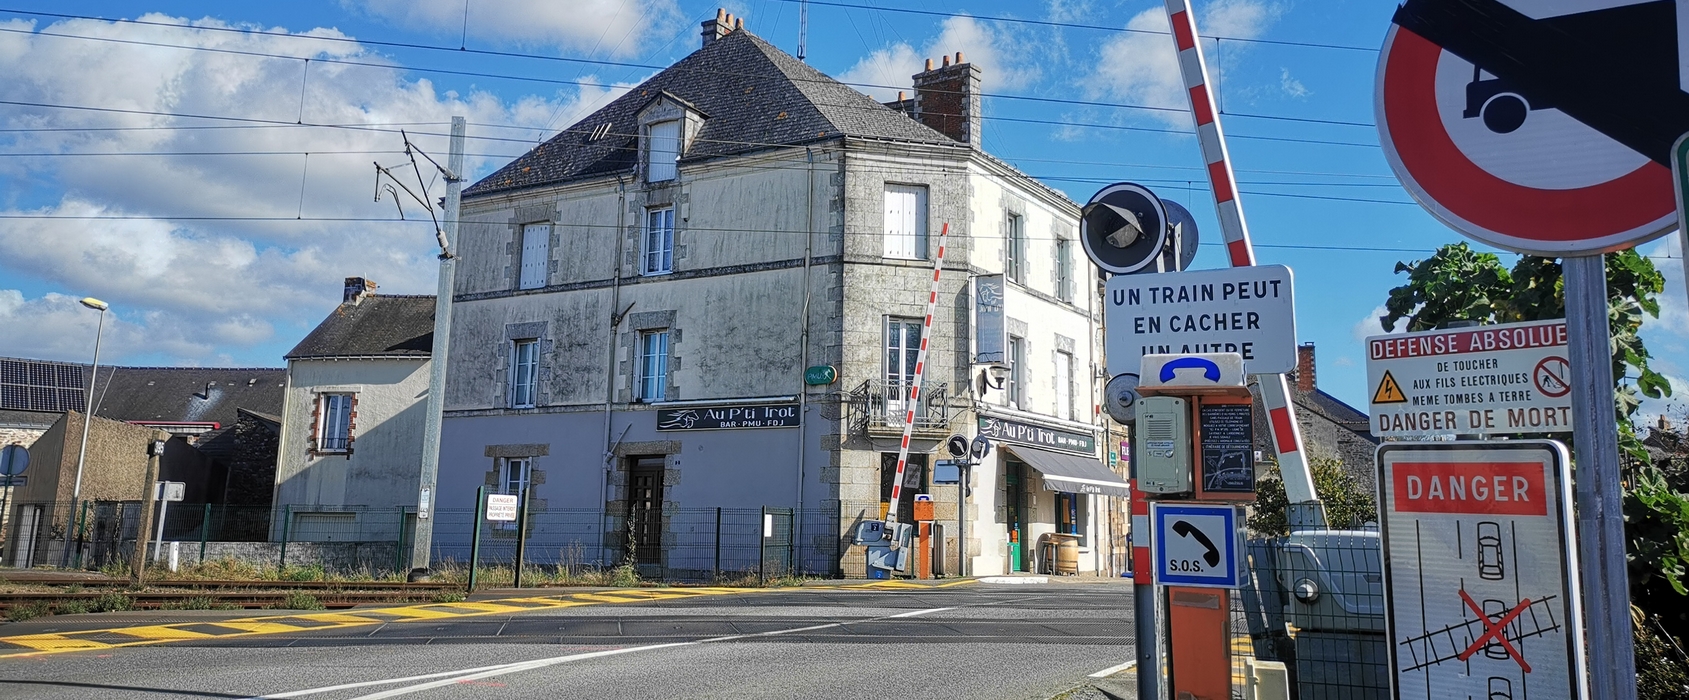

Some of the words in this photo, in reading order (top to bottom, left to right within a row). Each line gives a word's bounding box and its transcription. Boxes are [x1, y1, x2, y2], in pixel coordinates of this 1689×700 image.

[1113, 288, 1140, 306] UN
[1149, 284, 1214, 304] TRAIN
[1222, 280, 1281, 300] PEUT
[1134, 316, 1160, 334] EN
[1170, 312, 1260, 332] CACHER
[1372, 334, 1458, 359] DEFENSE
[1470, 325, 1567, 351] ABSOLUE
[1437, 362, 1449, 372] DE
[1453, 358, 1498, 372] TOUCHER
[1413, 379, 1431, 390] AUX
[1436, 378, 1456, 388] FILS
[1461, 372, 1528, 386] ELECTRIQUES
[1412, 395, 1440, 406] MEME
[1444, 392, 1484, 405] TOMBES
[1488, 392, 1496, 402] A
[1498, 390, 1532, 402] TERRE
[704, 409, 724, 420] Au
[730, 408, 755, 420] P'ti
[762, 406, 795, 418] Trot
[1379, 411, 1456, 432] DANGER
[1469, 410, 1495, 428] DE
[1508, 406, 1570, 428] MORT
[1002, 422, 1016, 438] Au
[1018, 425, 1034, 442] P'ti
[1036, 428, 1055, 444] Trot
[1407, 475, 1529, 502] DANGER
[1170, 559, 1204, 572] S.O.S.
